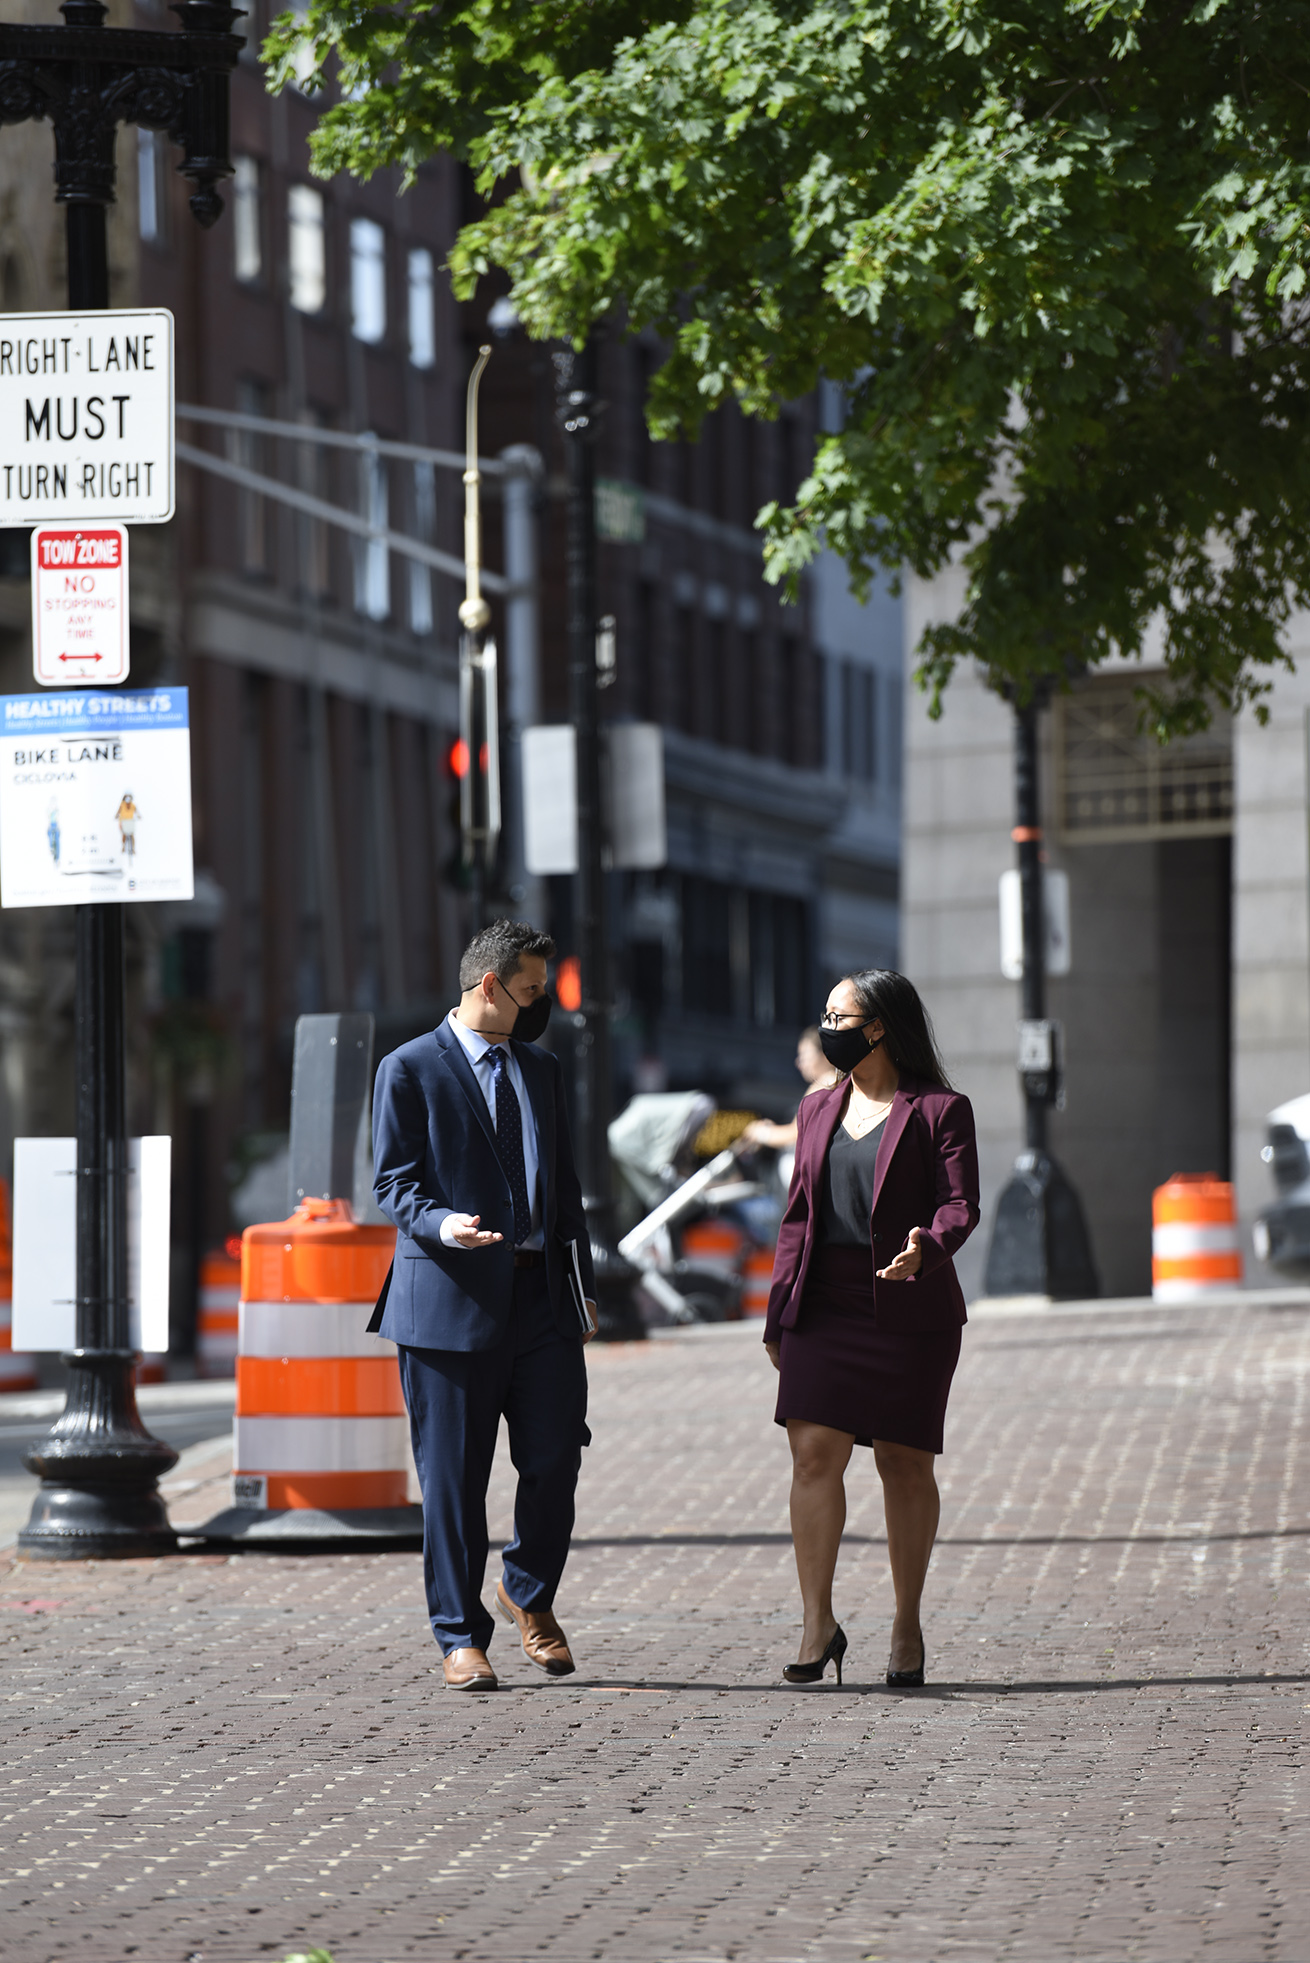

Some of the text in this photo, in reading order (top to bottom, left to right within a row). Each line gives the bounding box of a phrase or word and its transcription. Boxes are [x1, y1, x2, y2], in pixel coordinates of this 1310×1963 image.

[1, 335, 155, 375] RIGHT LANE
[25, 396, 130, 441] MUST
[3, 462, 155, 500] TURN RIGHT
[41, 538, 119, 565] TOW ZONE
[65, 575, 95, 593] NO
[45, 599, 115, 611] STOPPING
[68, 615, 93, 625] ANY
[67, 628, 94, 639] TIME
[5, 694, 172, 719] HEALTHY STREETS
[15, 744, 123, 765] BIKE LANE
